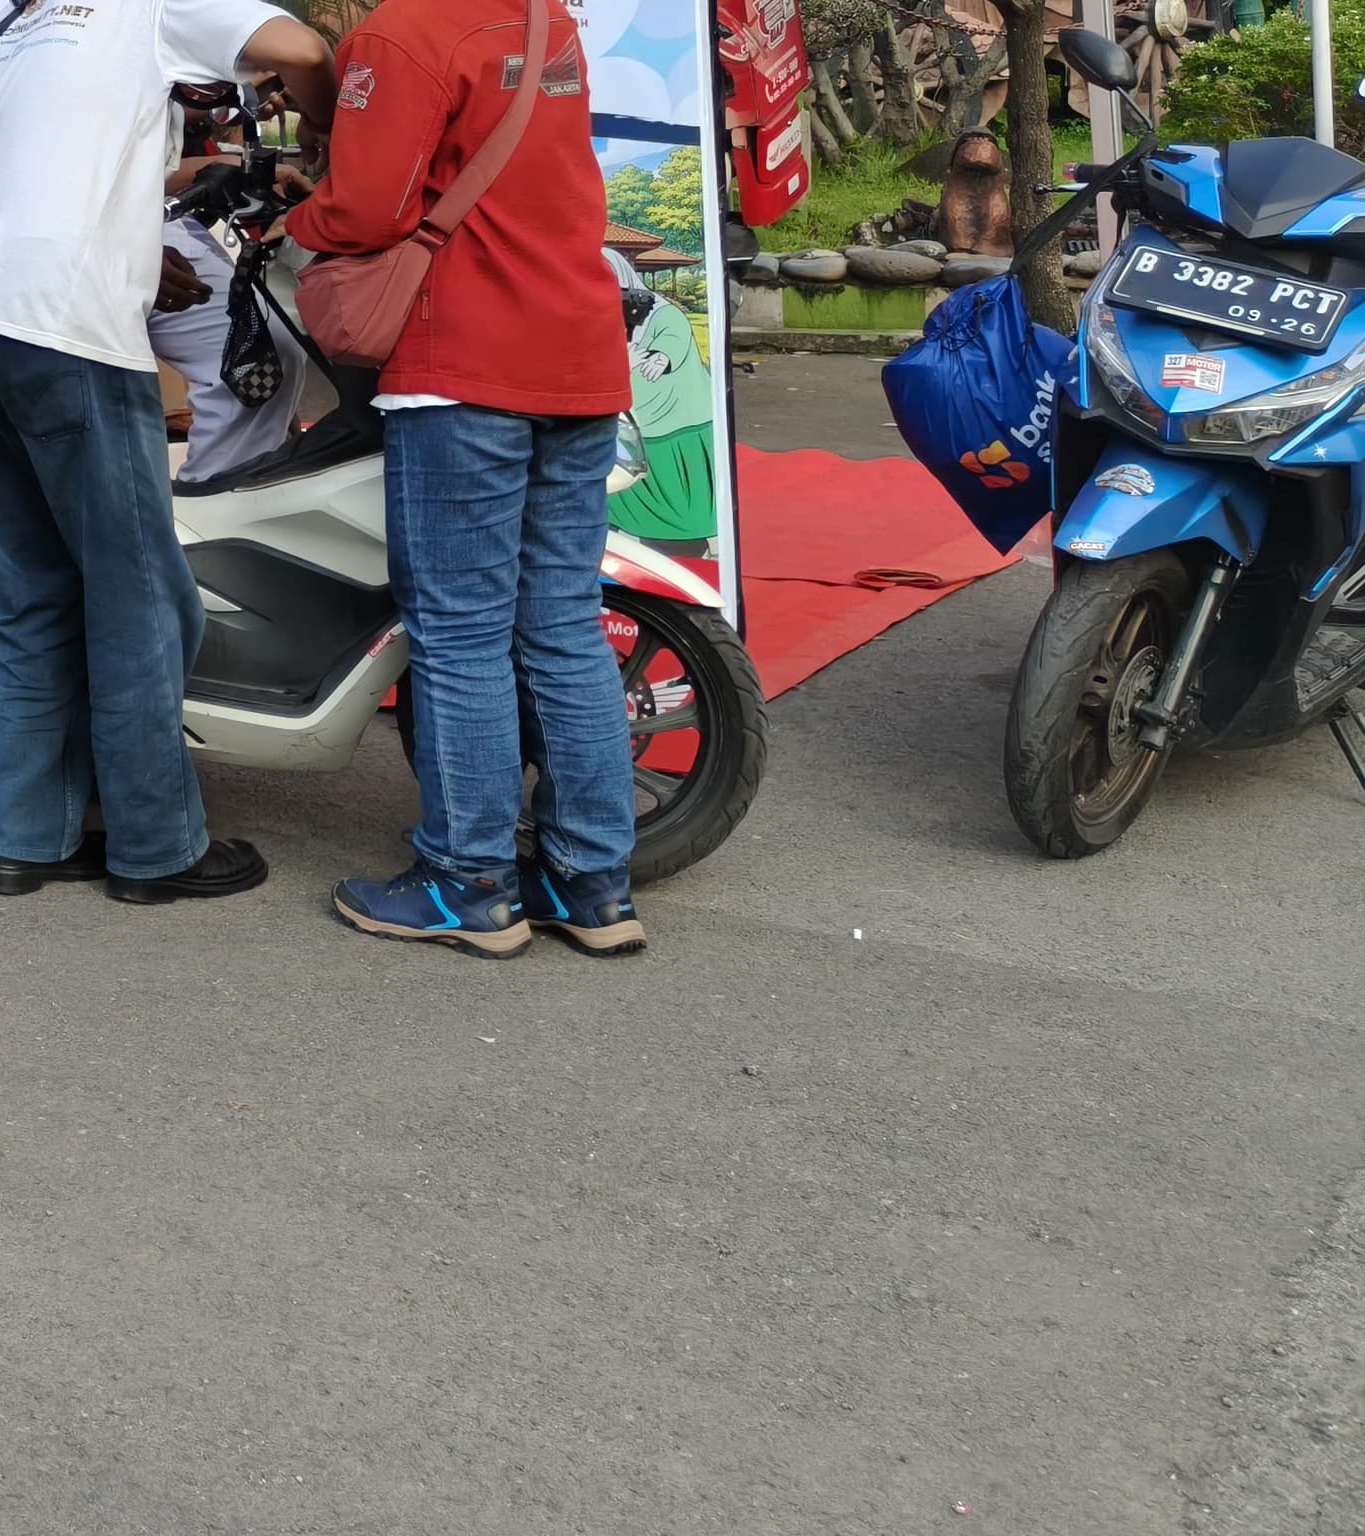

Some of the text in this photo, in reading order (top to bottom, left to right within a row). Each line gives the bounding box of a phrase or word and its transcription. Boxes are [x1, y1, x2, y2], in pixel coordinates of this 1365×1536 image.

[1135, 252, 1339, 315] B 3382 PCT
[1186, 358, 1221, 372] MOTOR
[1010, 370, 1056, 449] bank
